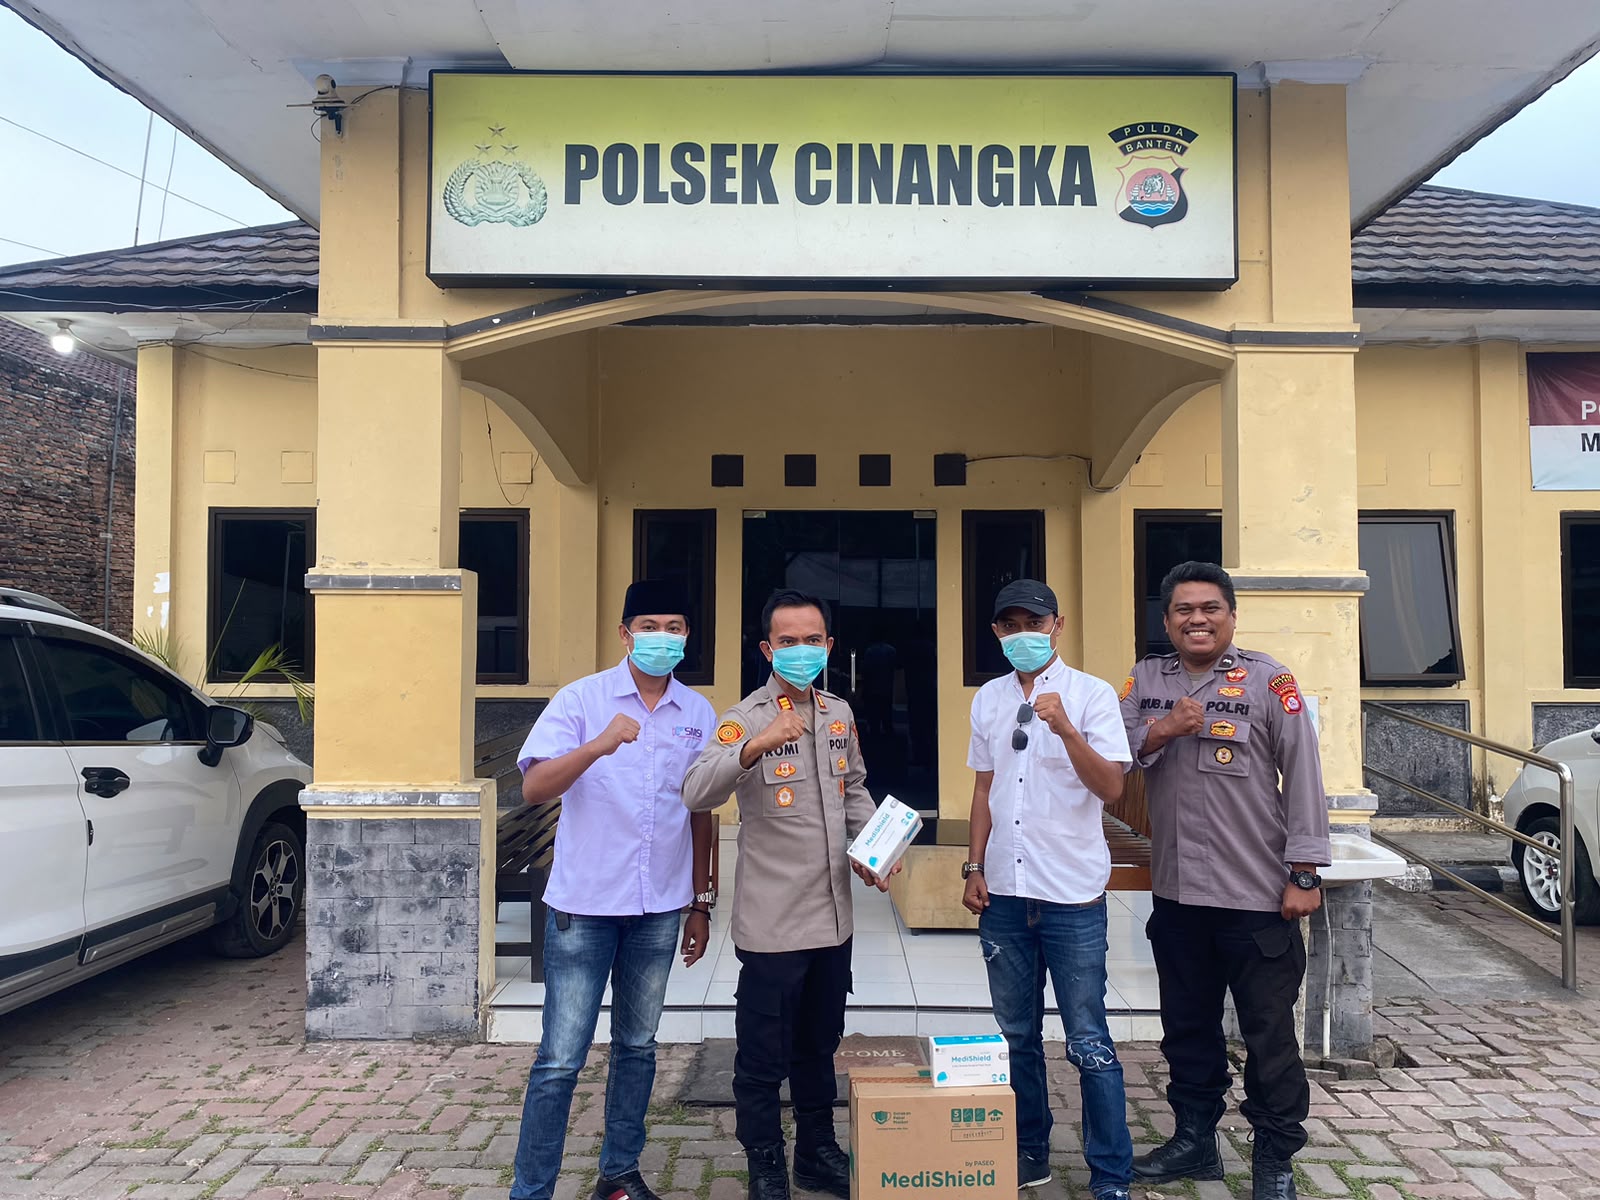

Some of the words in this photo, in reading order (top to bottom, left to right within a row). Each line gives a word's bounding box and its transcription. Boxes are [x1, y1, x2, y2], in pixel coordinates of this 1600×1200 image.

[1123, 124, 1183, 136] POLDA
[1125, 139, 1182, 153] BANTEN
[564, 141, 780, 205] POLSEK
[794, 142, 1098, 208] CINANGKA
[1581, 400, 1600, 420] P
[1205, 700, 1250, 716] POLRI
[865, 813, 890, 846] MediShield
[838, 1049, 905, 1058] COME
[951, 1054, 992, 1063] MediShield
[881, 1169, 995, 1188] MediShield
